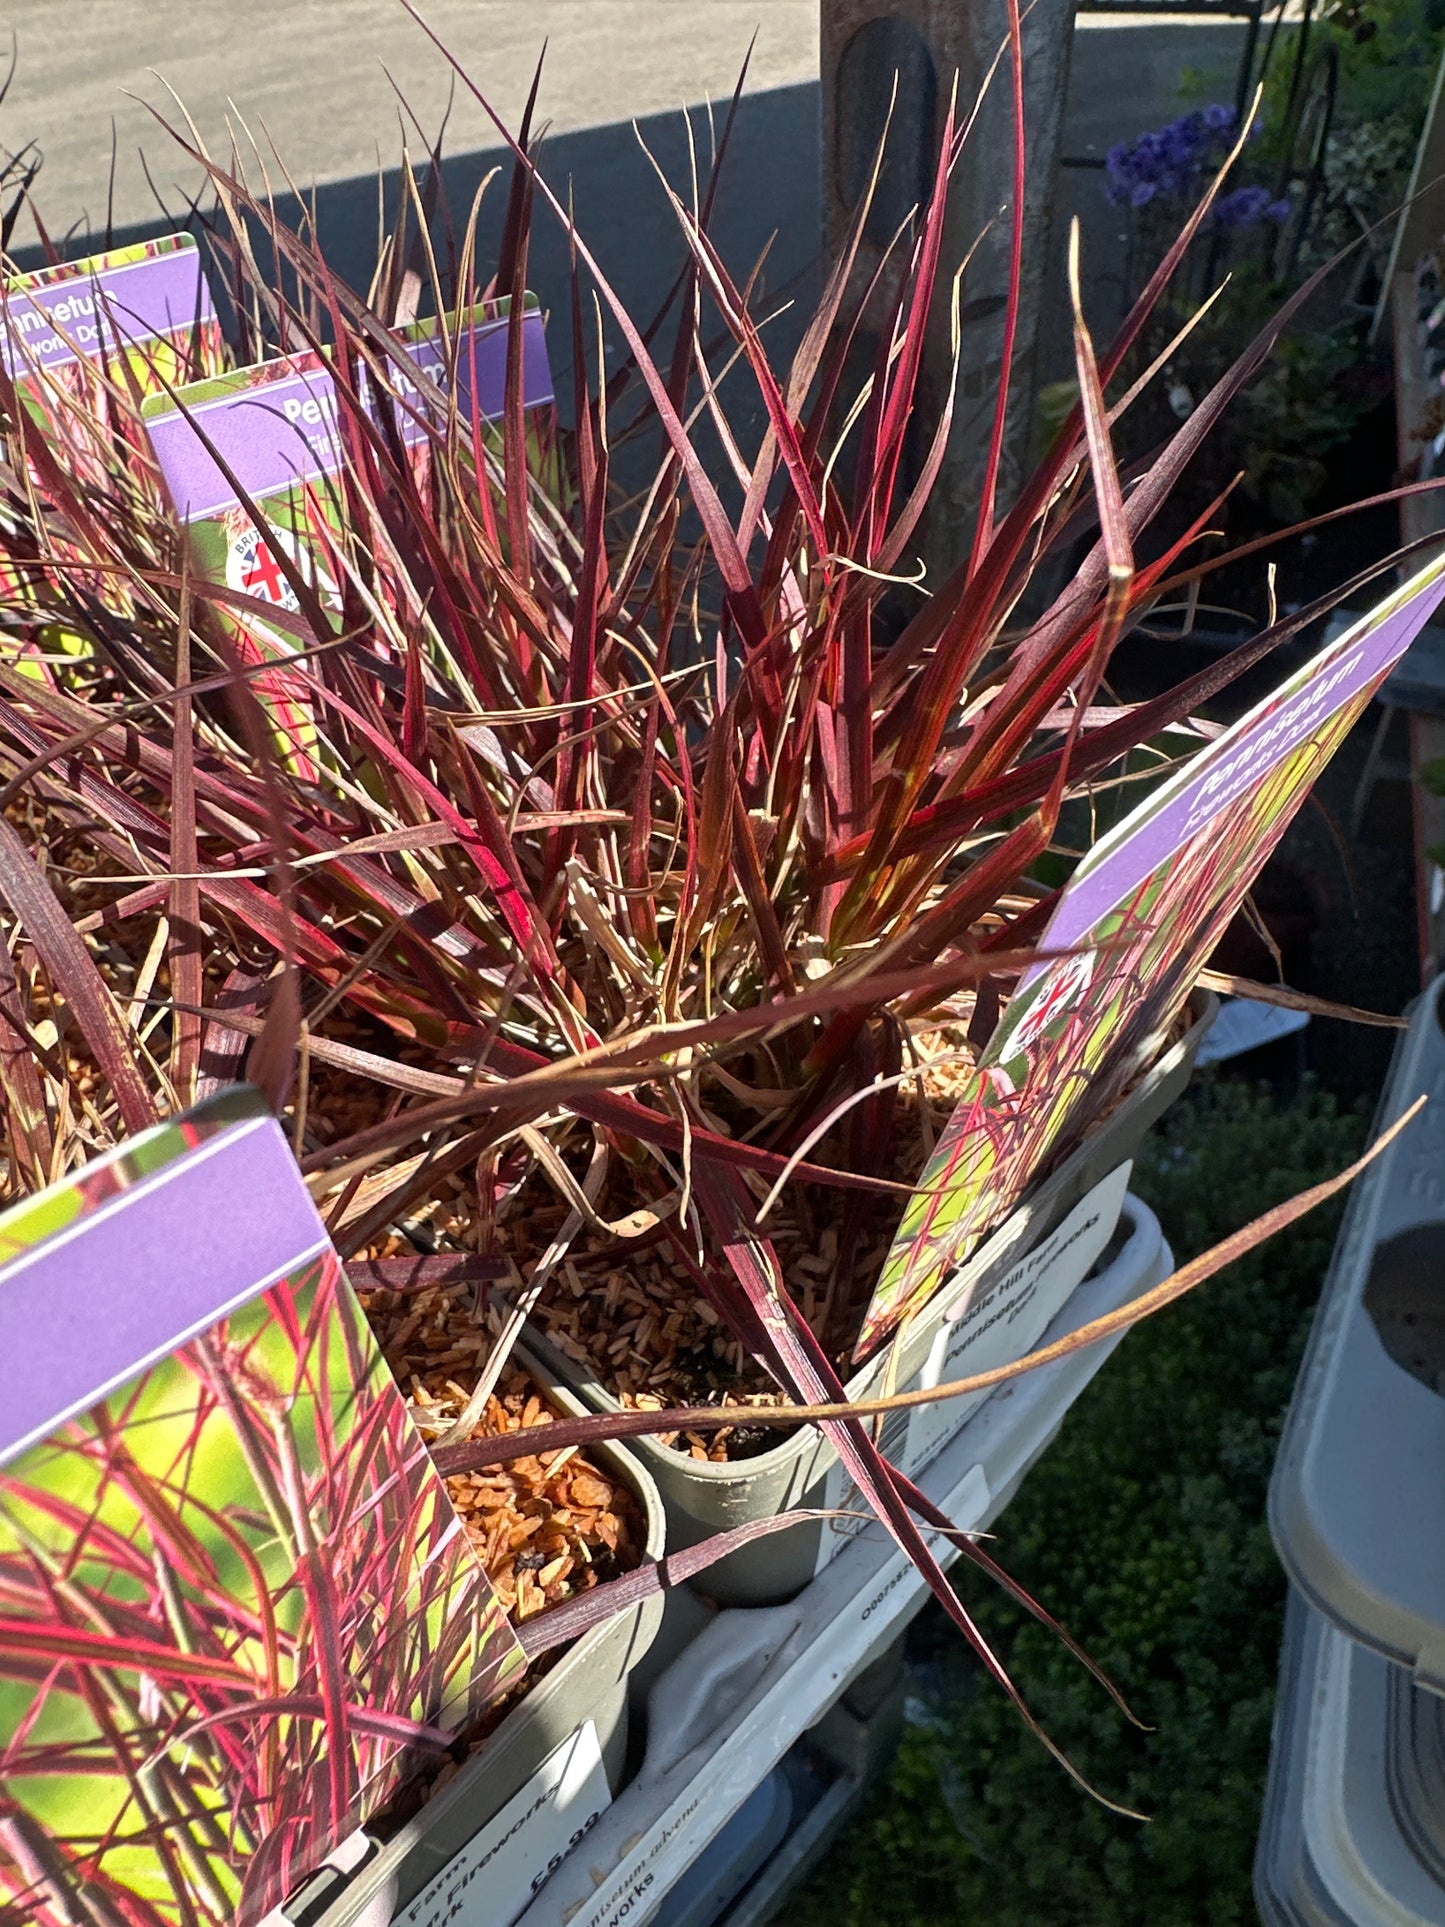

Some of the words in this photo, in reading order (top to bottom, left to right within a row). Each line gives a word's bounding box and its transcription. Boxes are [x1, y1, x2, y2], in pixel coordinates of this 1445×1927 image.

[1189, 651, 1365, 812] Pennisetum
[998, 1267, 1024, 1296] Hill
[447, 1782, 561, 1906] Fireworks
[408, 1856, 467, 1922] Farm
[587, 1859, 646, 1927] nisetum
